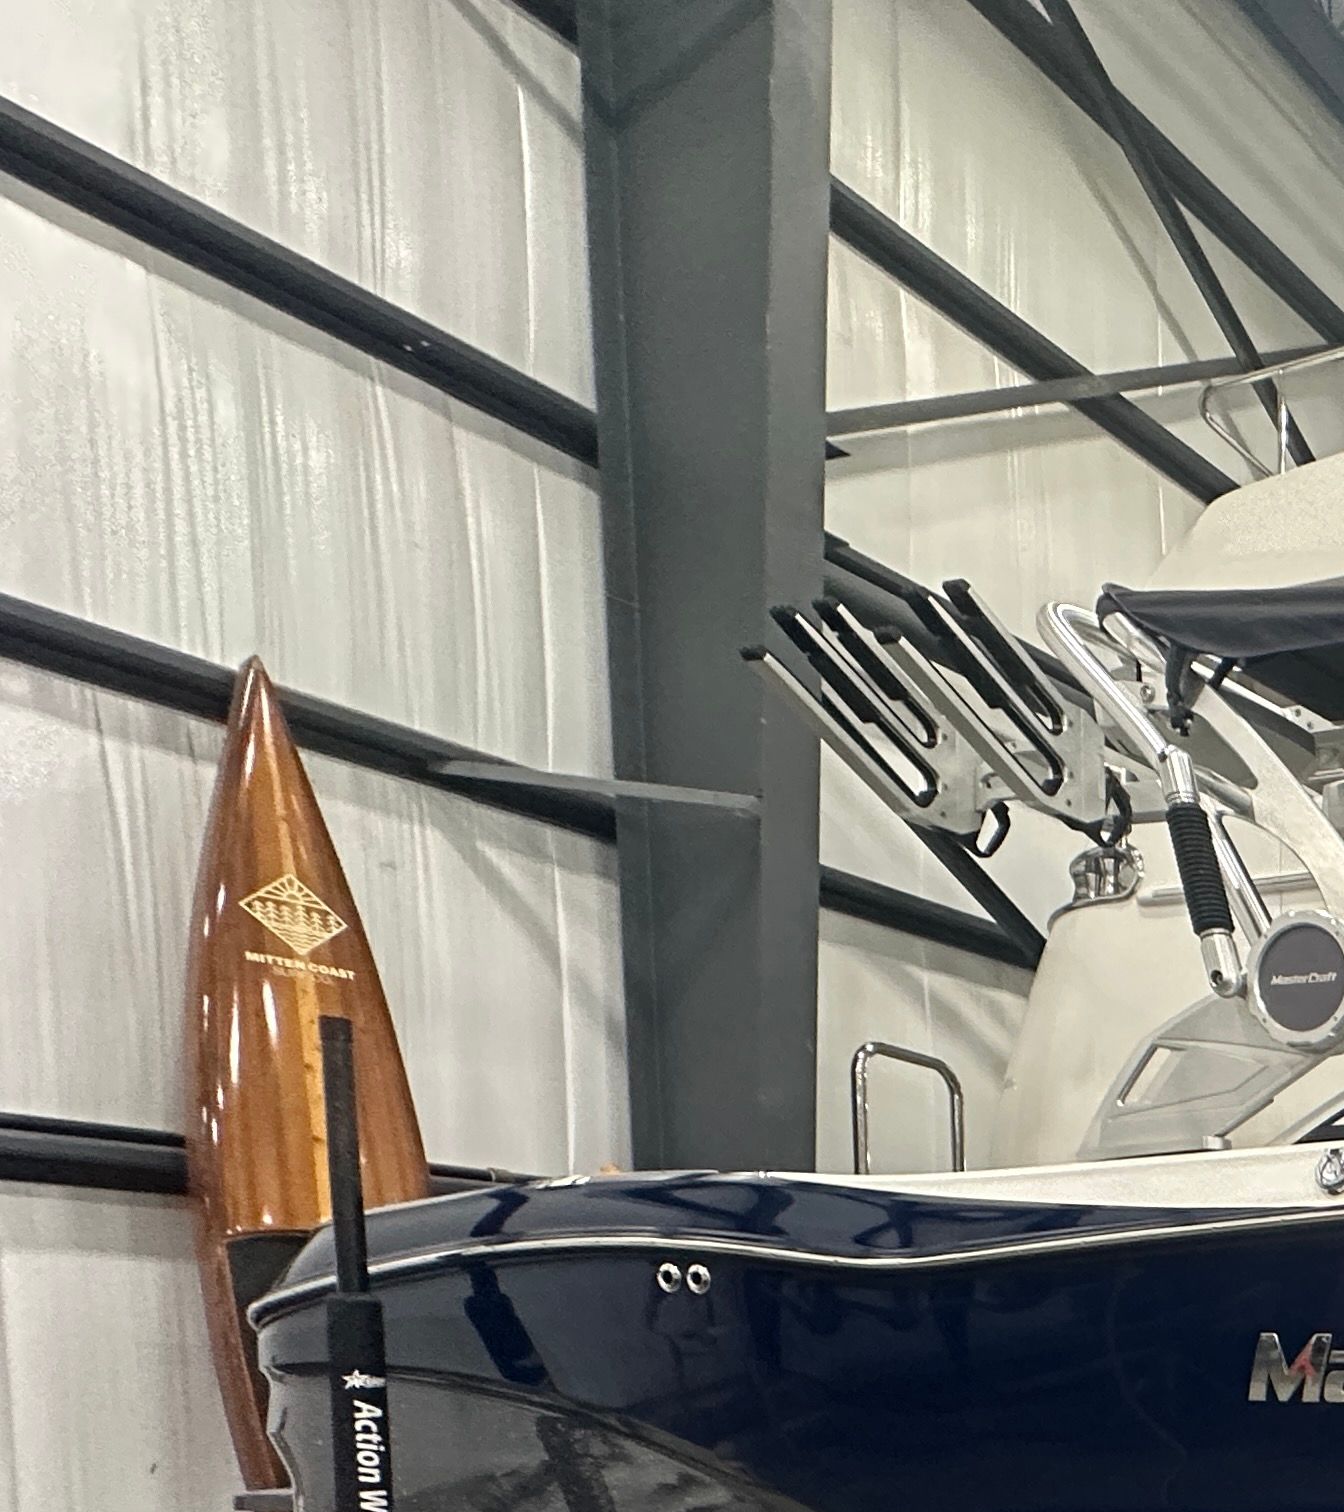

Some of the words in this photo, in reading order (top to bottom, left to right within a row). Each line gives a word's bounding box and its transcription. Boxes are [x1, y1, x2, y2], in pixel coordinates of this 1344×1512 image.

[244, 950, 306, 971] MITTEN
[307, 961, 356, 981] COAST
[354, 1400, 385, 1482] Action
